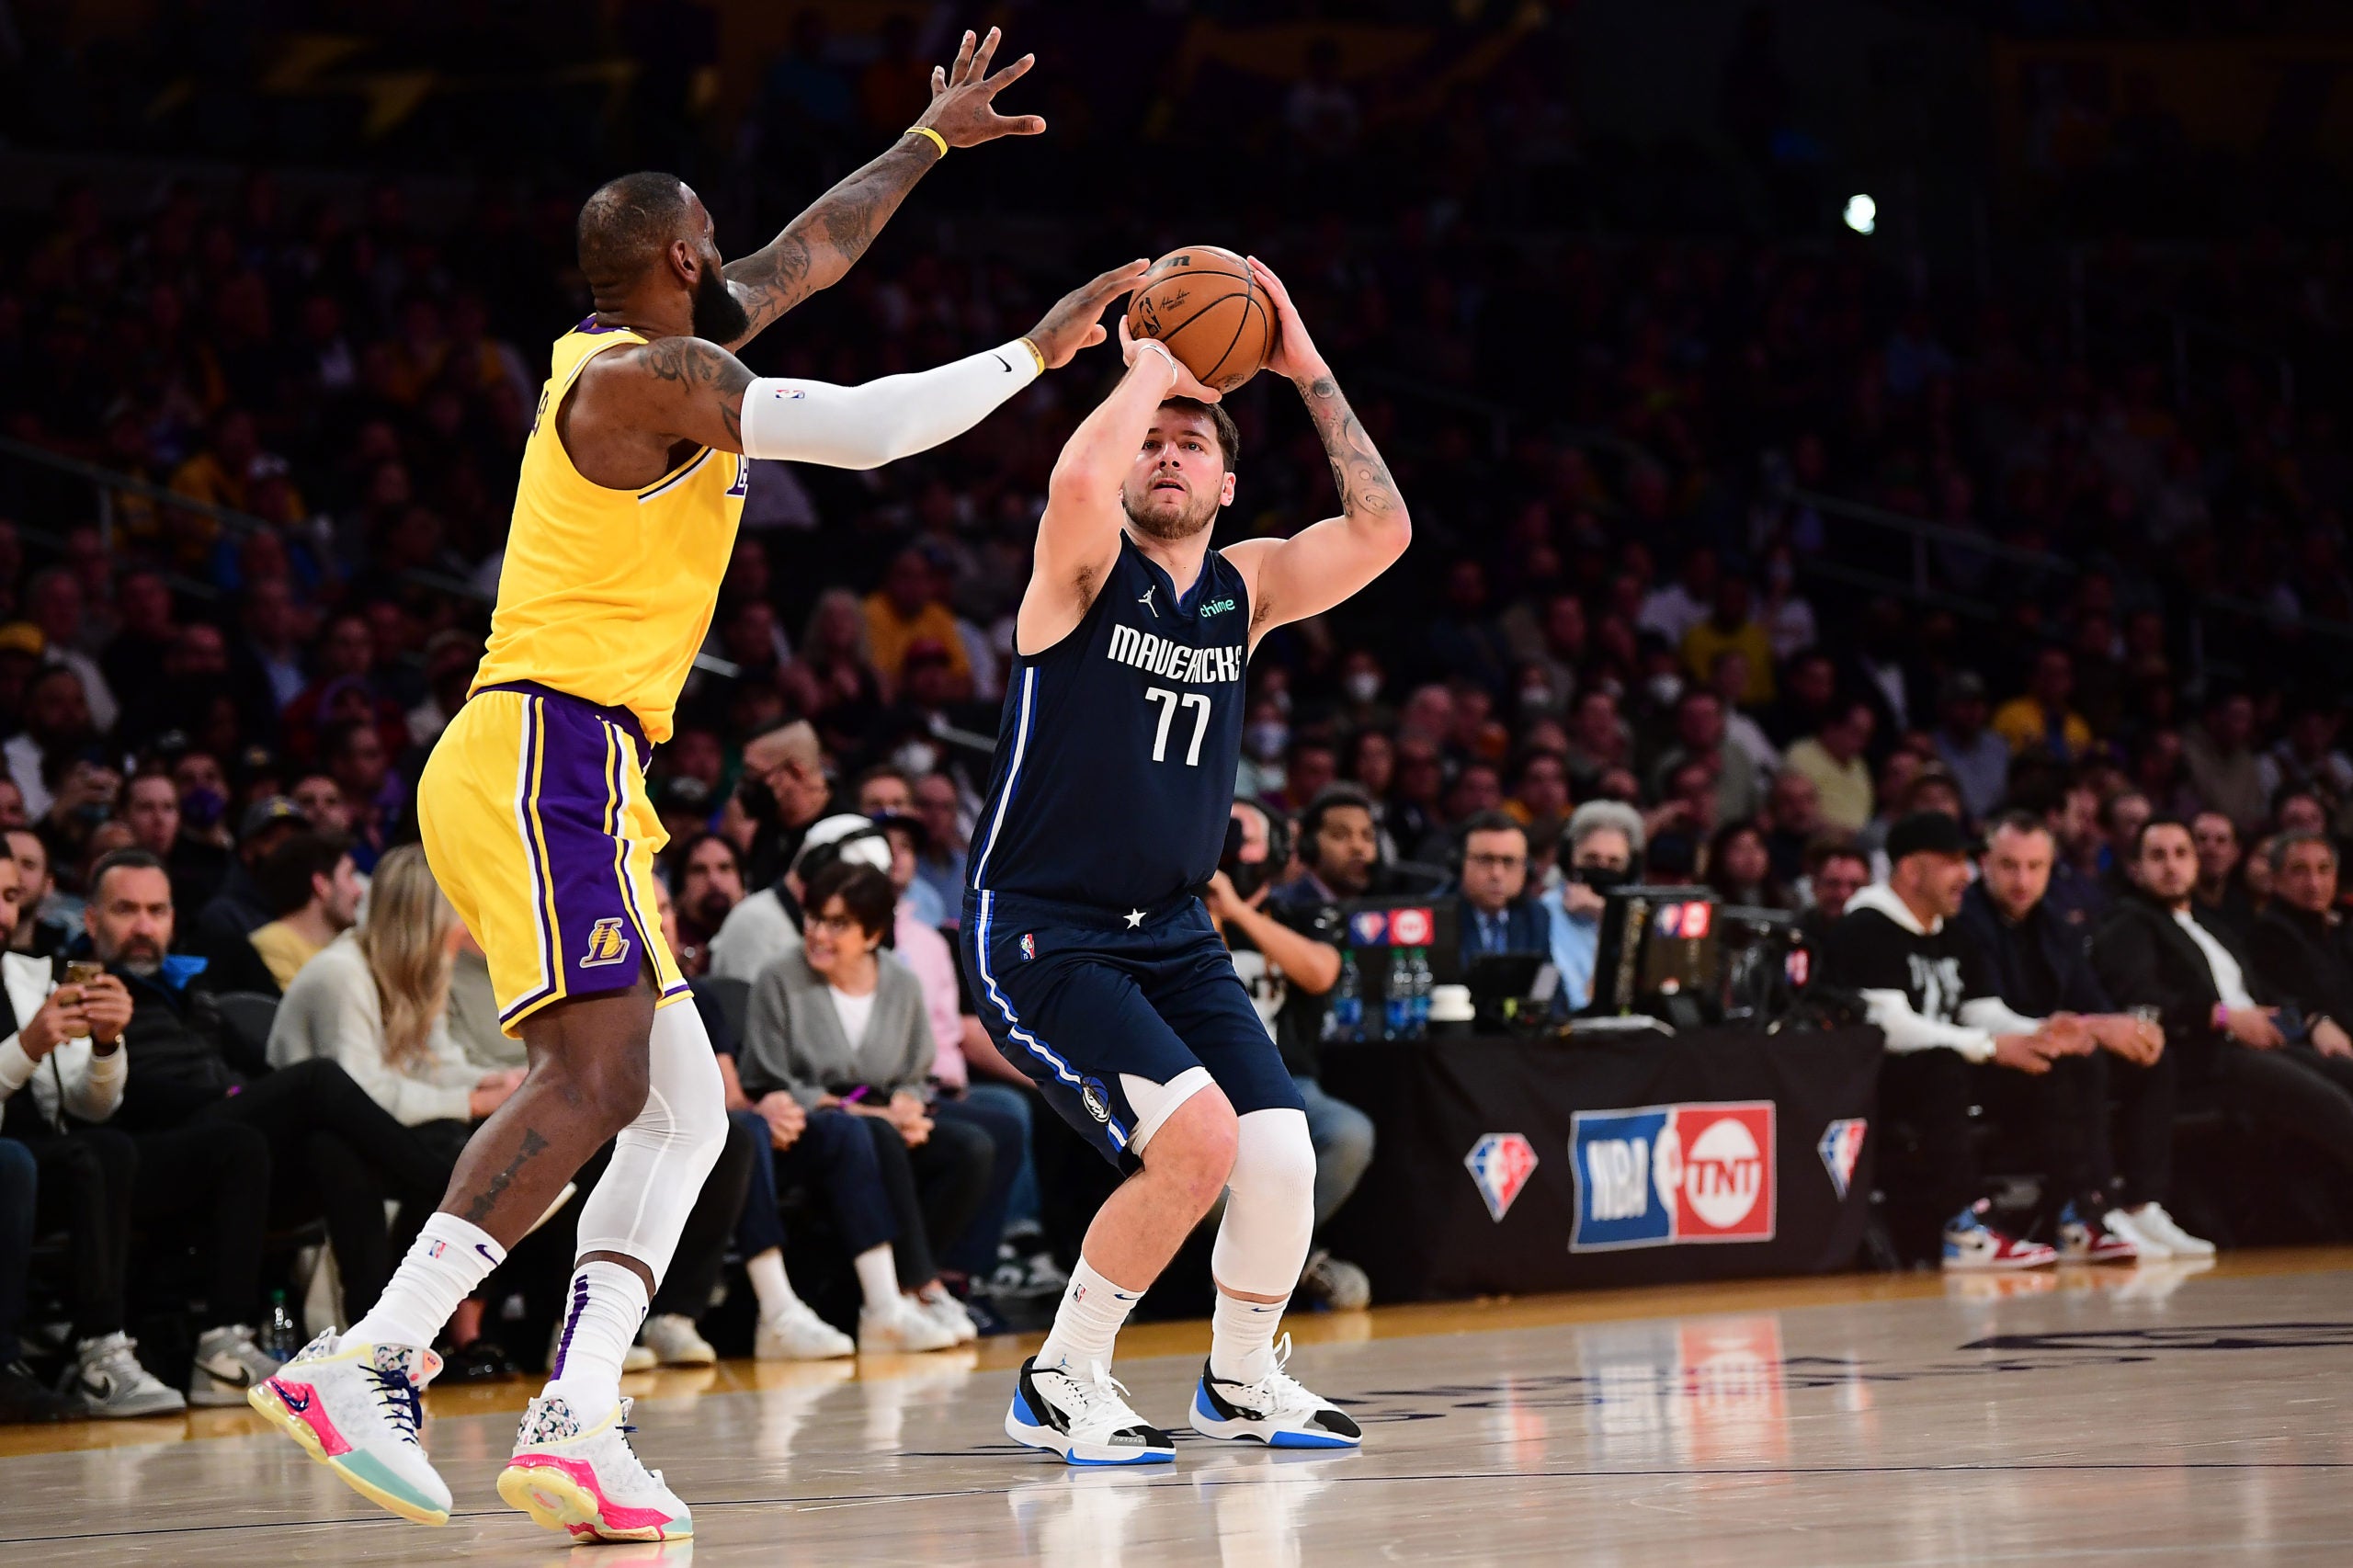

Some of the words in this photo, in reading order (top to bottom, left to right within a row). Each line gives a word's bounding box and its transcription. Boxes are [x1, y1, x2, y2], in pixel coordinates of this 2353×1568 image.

[1199, 599, 1236, 618] chime
[1145, 687, 1211, 767] 77
[1586, 1136, 1650, 1221] NBA
[1687, 1158, 1761, 1199] TNT
